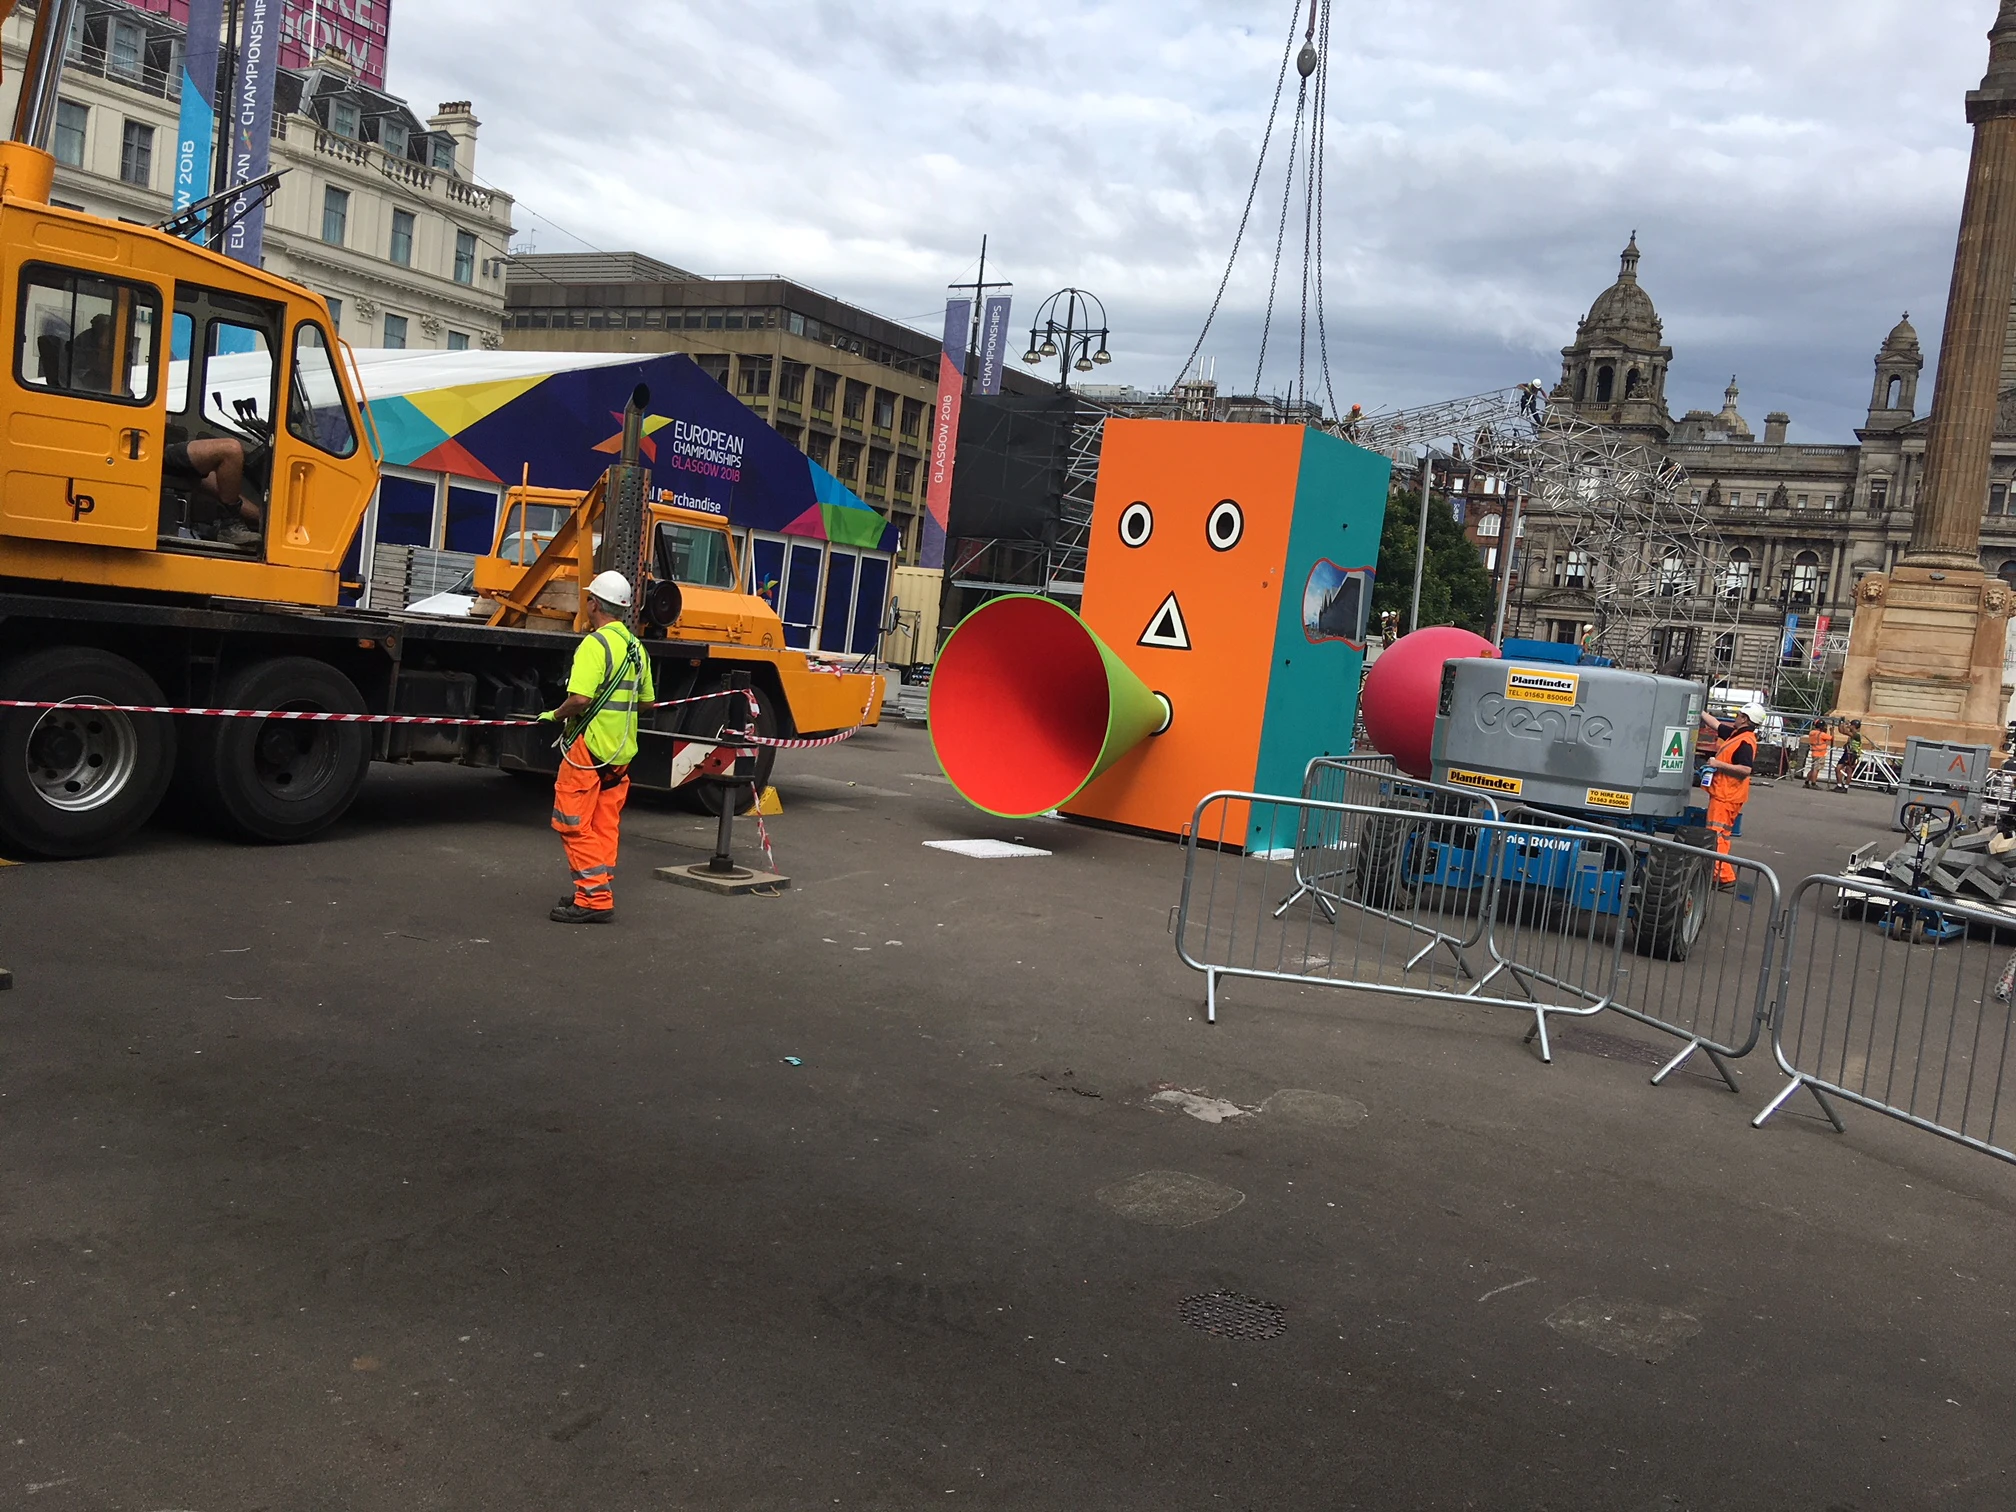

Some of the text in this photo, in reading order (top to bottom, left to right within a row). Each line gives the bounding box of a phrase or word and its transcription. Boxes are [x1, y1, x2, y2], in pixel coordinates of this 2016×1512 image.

[179, 140, 195, 185] 2018
[231, 154, 251, 249] EUOAN
[982, 304, 1002, 387] CHAMPIONSHIPS
[674, 420, 744, 455] EUROPEAN
[934, 394, 953, 484] GLASGOW 2018
[673, 440, 742, 468] CHAMPIONSHIPS
[672, 455, 740, 482] GLASGOW 2018
[657, 487, 721, 513] rchandise
[1511, 676, 1572, 688] Plantfinder
[1508, 689, 1573, 702] TEL: 01563 850060
[1665, 731, 1683, 757] A
[1661, 759, 1683, 769] PLANT
[1450, 770, 1516, 790] Plantfinder
[1530, 836, 1571, 852] BOOM
